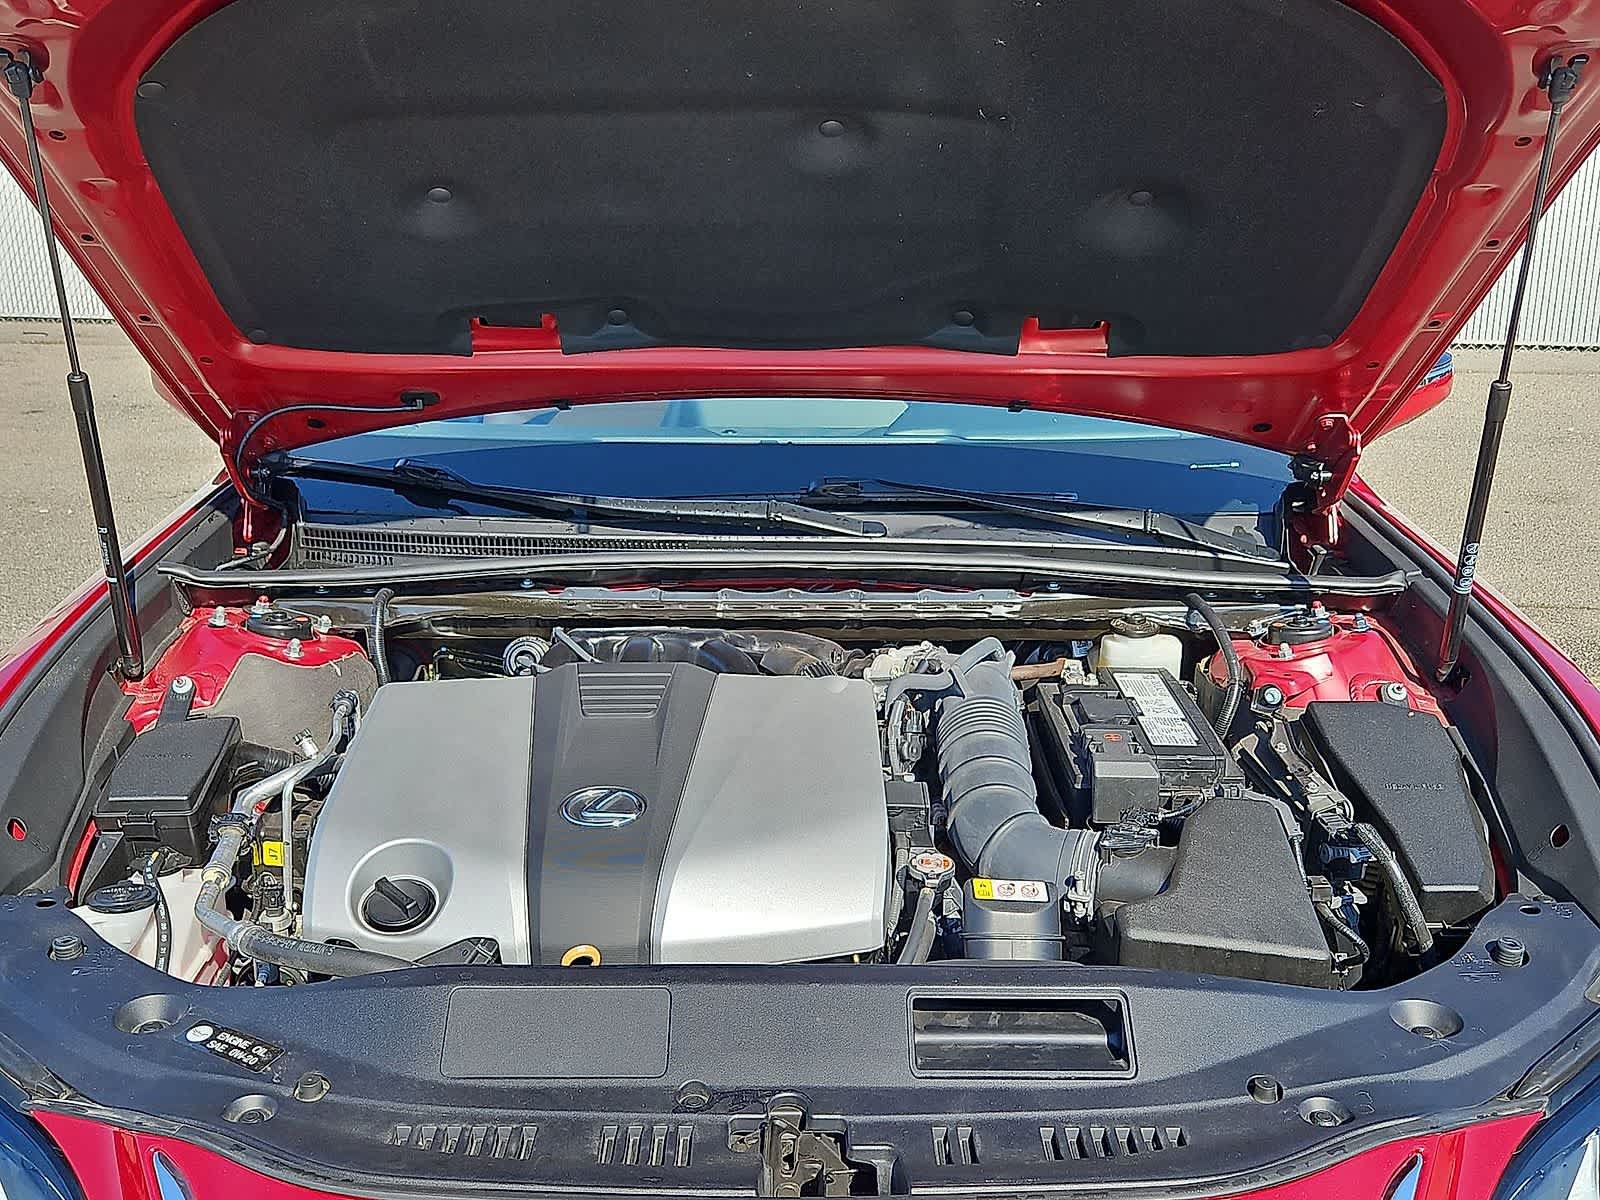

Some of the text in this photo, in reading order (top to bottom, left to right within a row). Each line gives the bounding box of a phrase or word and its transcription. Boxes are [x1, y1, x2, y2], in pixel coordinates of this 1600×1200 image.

[206, 1040, 258, 1065] SAE 0W-20
[217, 1032, 268, 1057] ENGINE OIL
